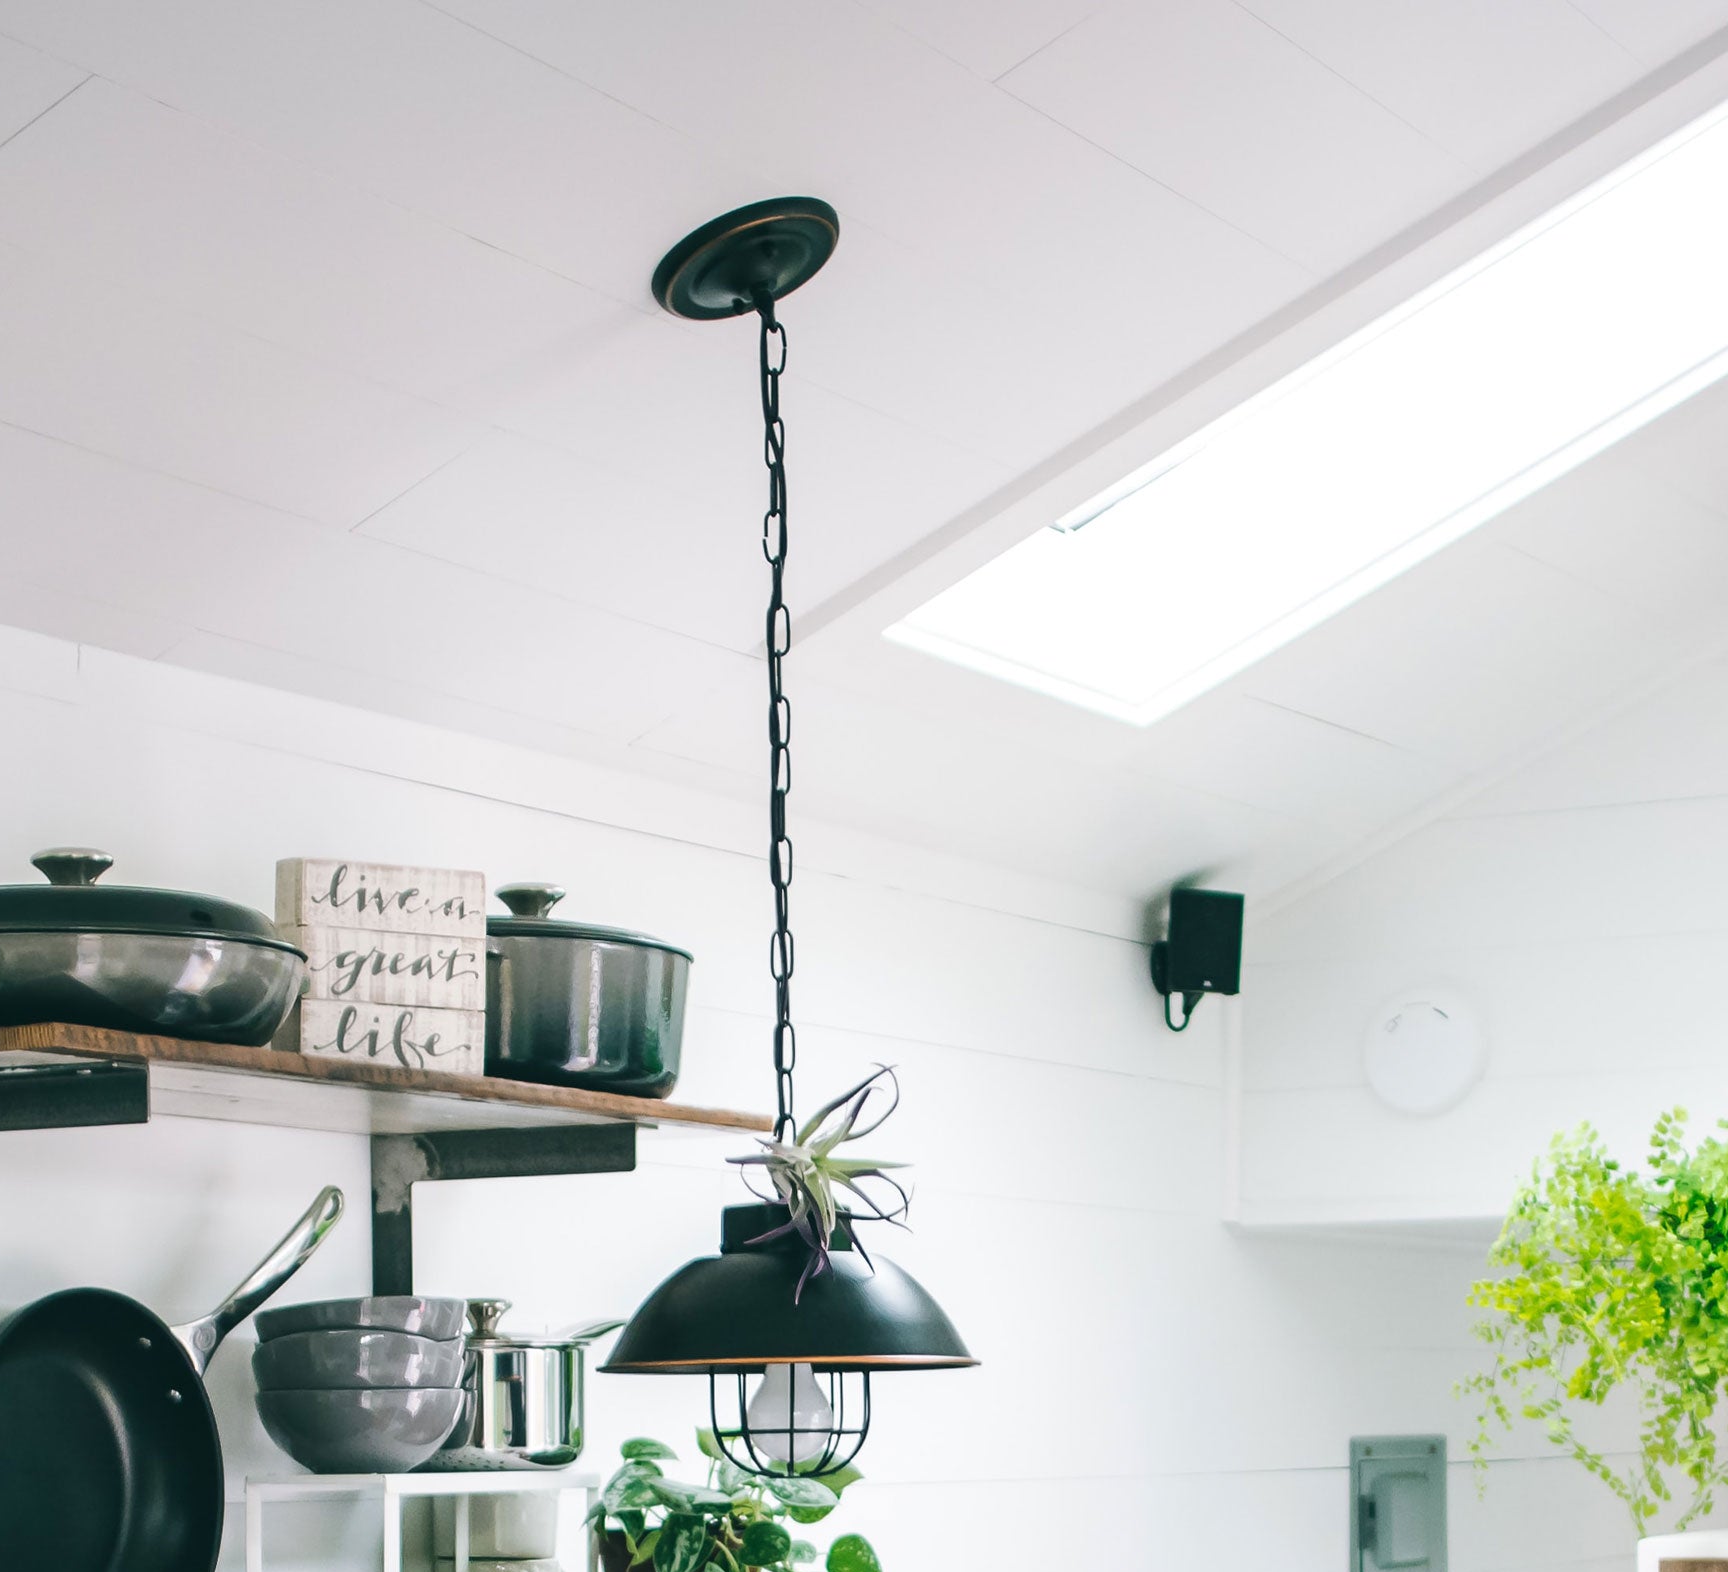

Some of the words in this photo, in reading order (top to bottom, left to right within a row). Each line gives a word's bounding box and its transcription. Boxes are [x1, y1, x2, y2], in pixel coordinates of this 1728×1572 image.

[311, 864, 429, 915] live
[429, 895, 480, 920] a
[310, 947, 480, 996] great
[313, 1005, 471, 1069] life
